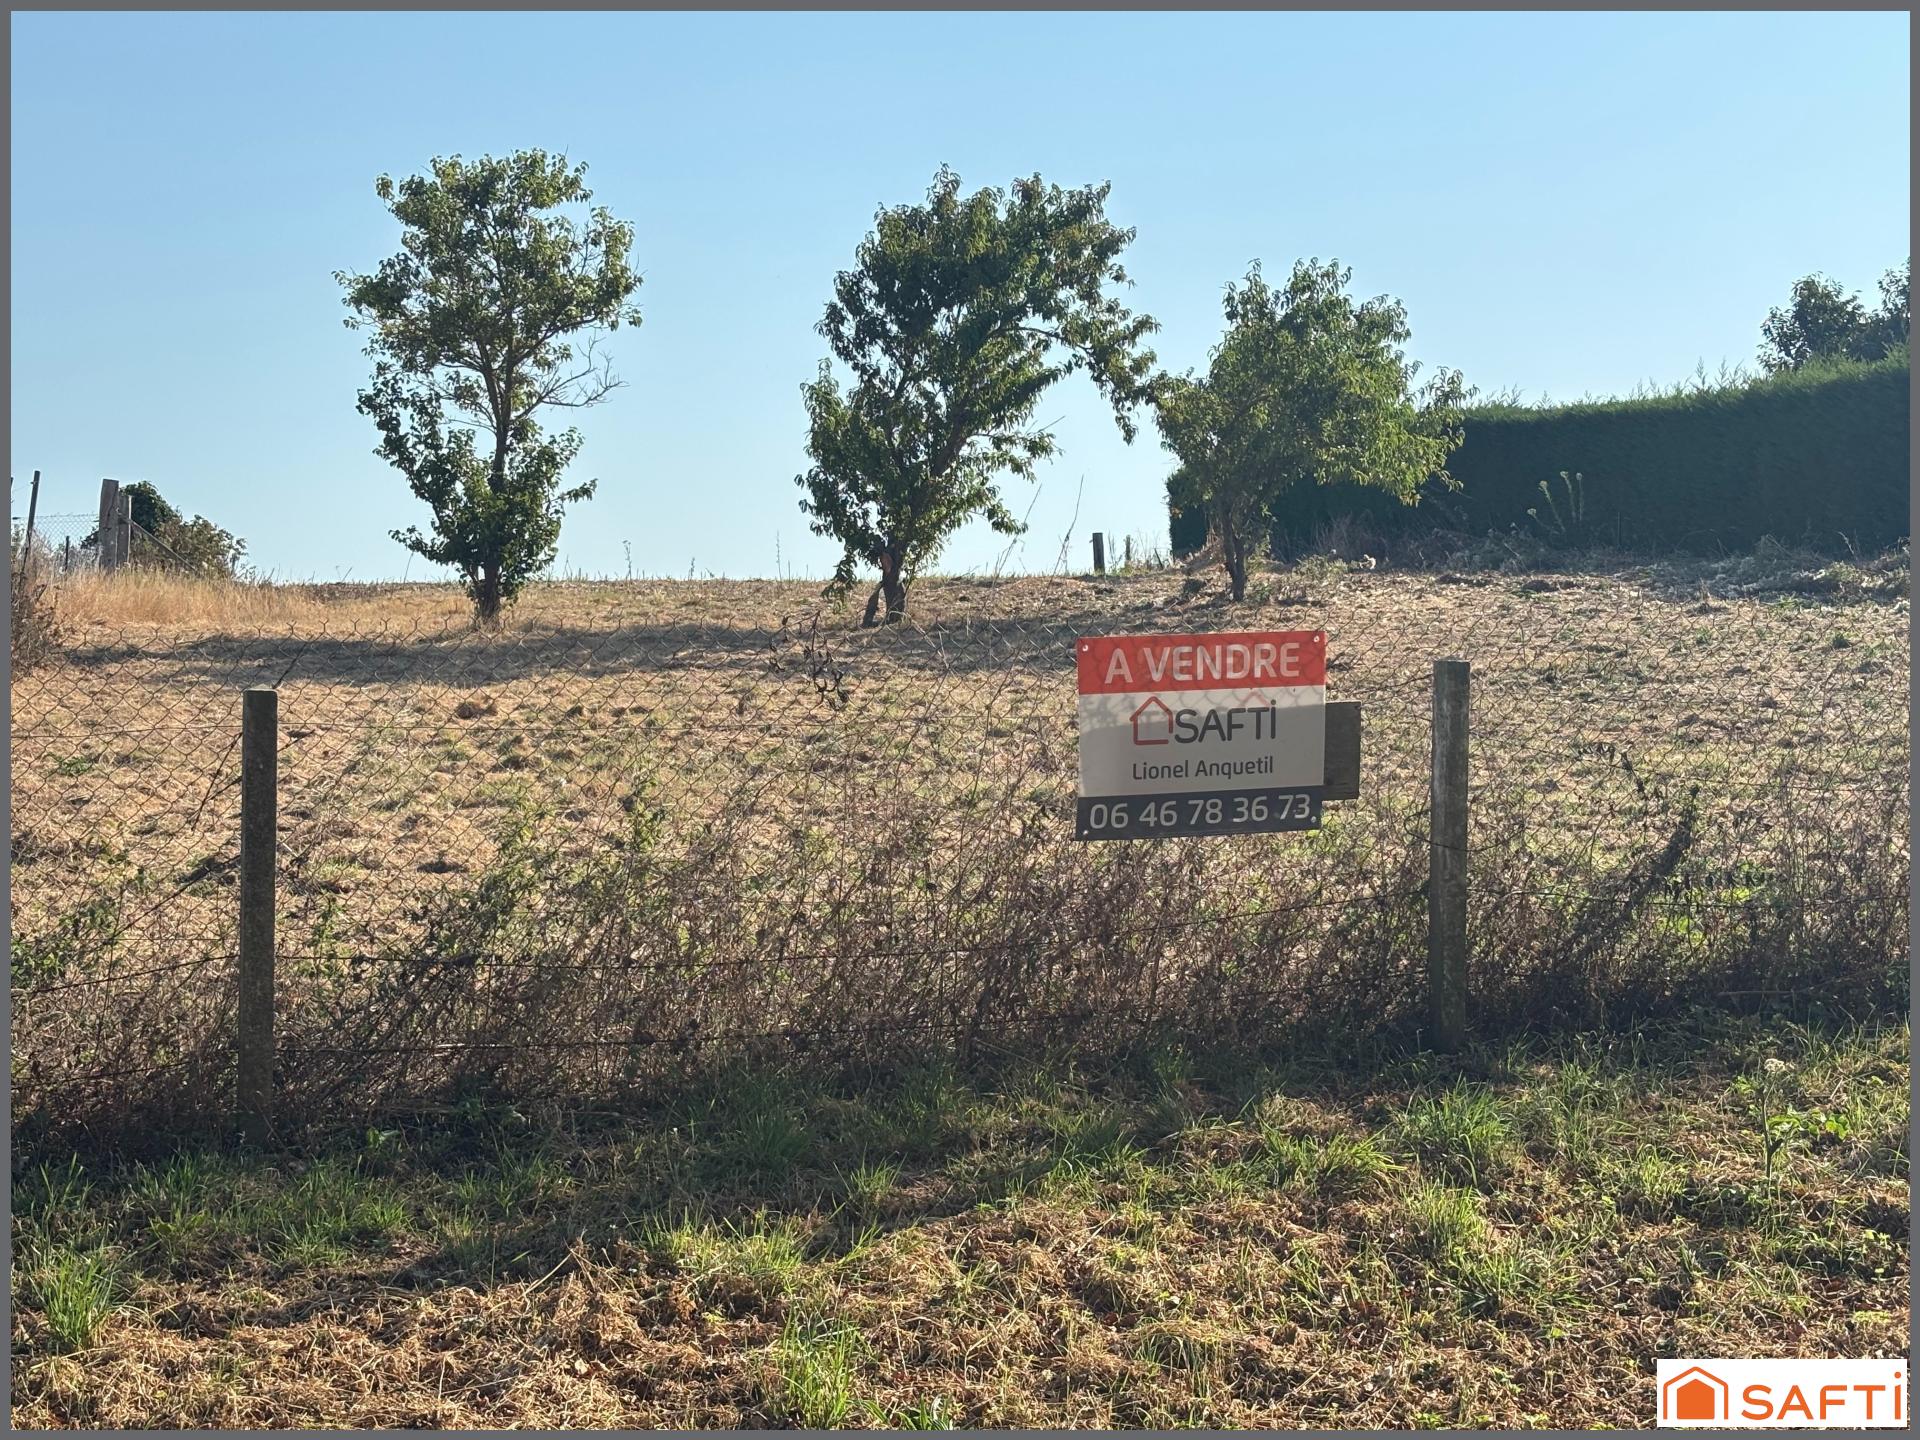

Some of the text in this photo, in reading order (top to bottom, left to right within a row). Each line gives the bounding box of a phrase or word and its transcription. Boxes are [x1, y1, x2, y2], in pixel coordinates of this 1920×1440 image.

[1104, 642, 1300, 685] A VENDRE
[1132, 756, 1273, 780] Lionel Anquetil
[1089, 793, 1310, 829] 06 46 78 36 73
